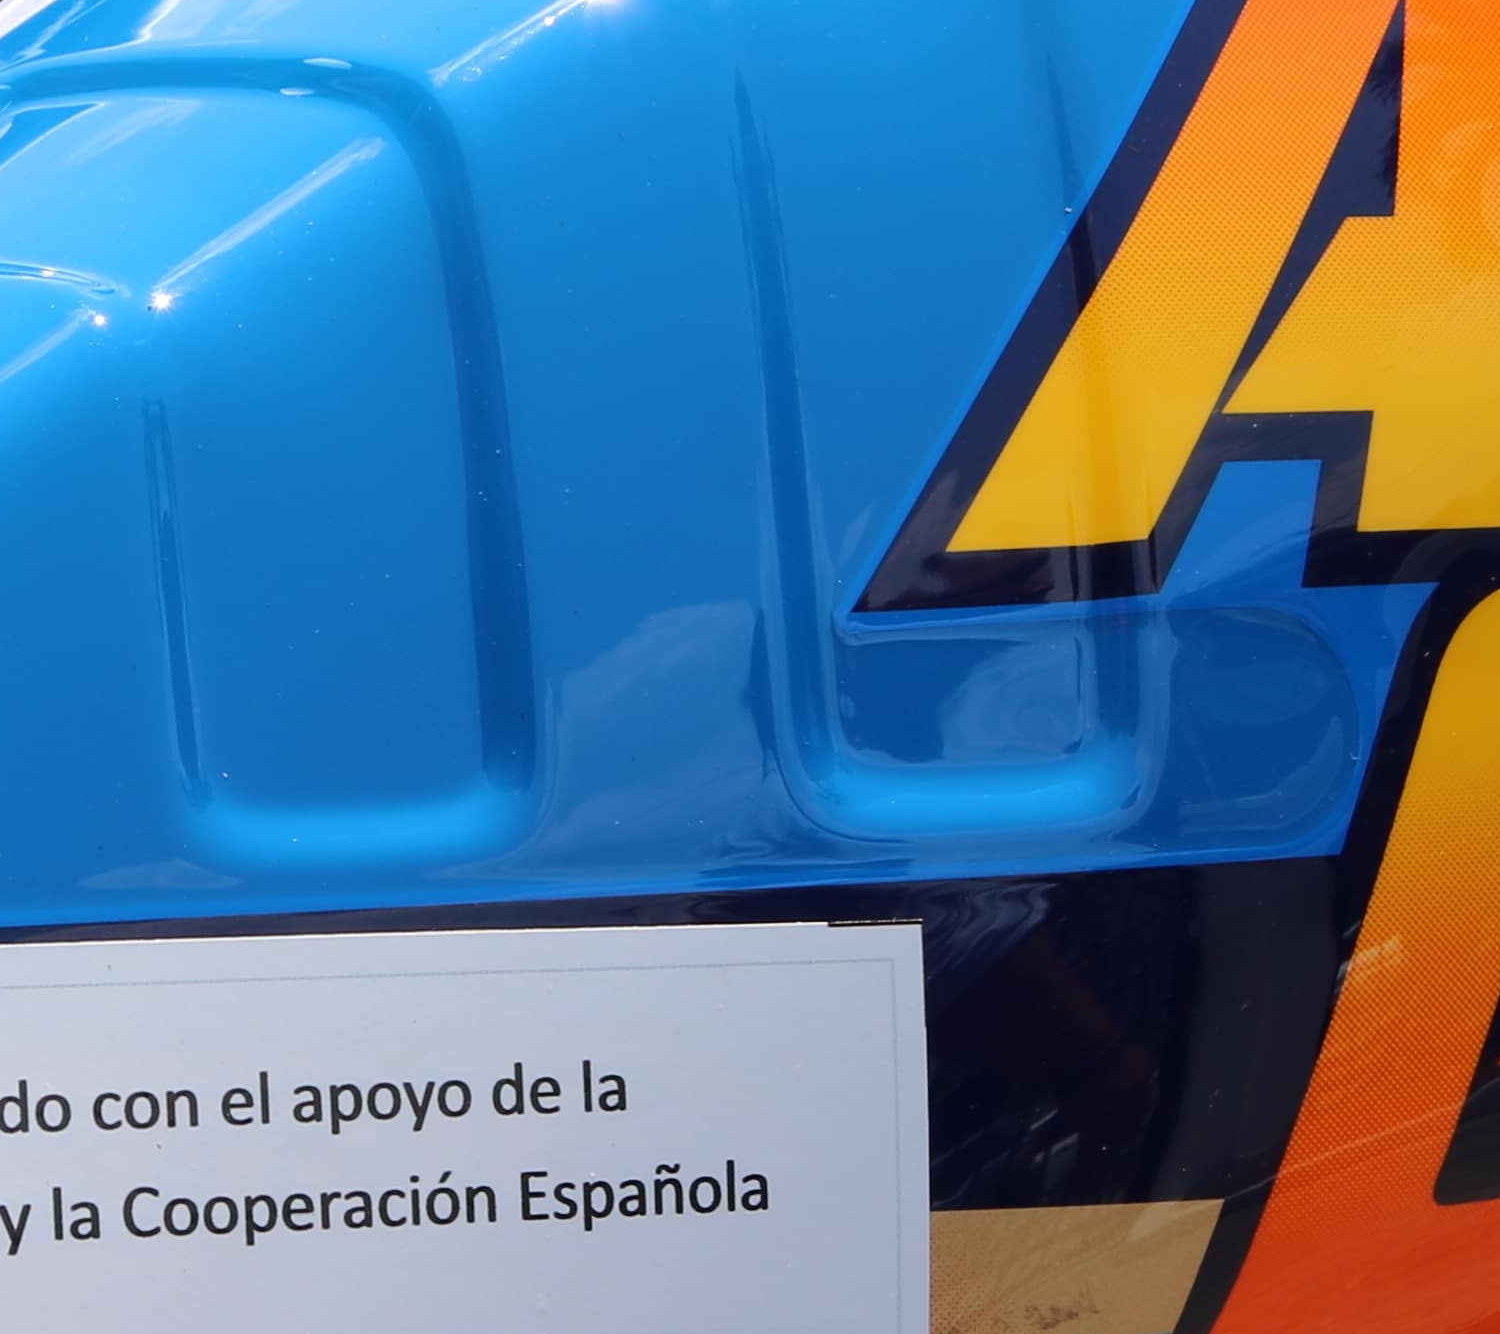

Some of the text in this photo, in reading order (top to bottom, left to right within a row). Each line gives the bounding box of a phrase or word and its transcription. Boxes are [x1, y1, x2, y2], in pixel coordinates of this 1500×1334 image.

[92, 1089, 200, 1131] con
[220, 1070, 271, 1127] el
[292, 1079, 472, 1136] apoyo
[491, 1061, 562, 1116] de
[582, 1059, 628, 1113] la
[52, 1186, 101, 1241] la
[122, 1170, 497, 1247] Cooperación
[519, 1159, 769, 1232] Española
